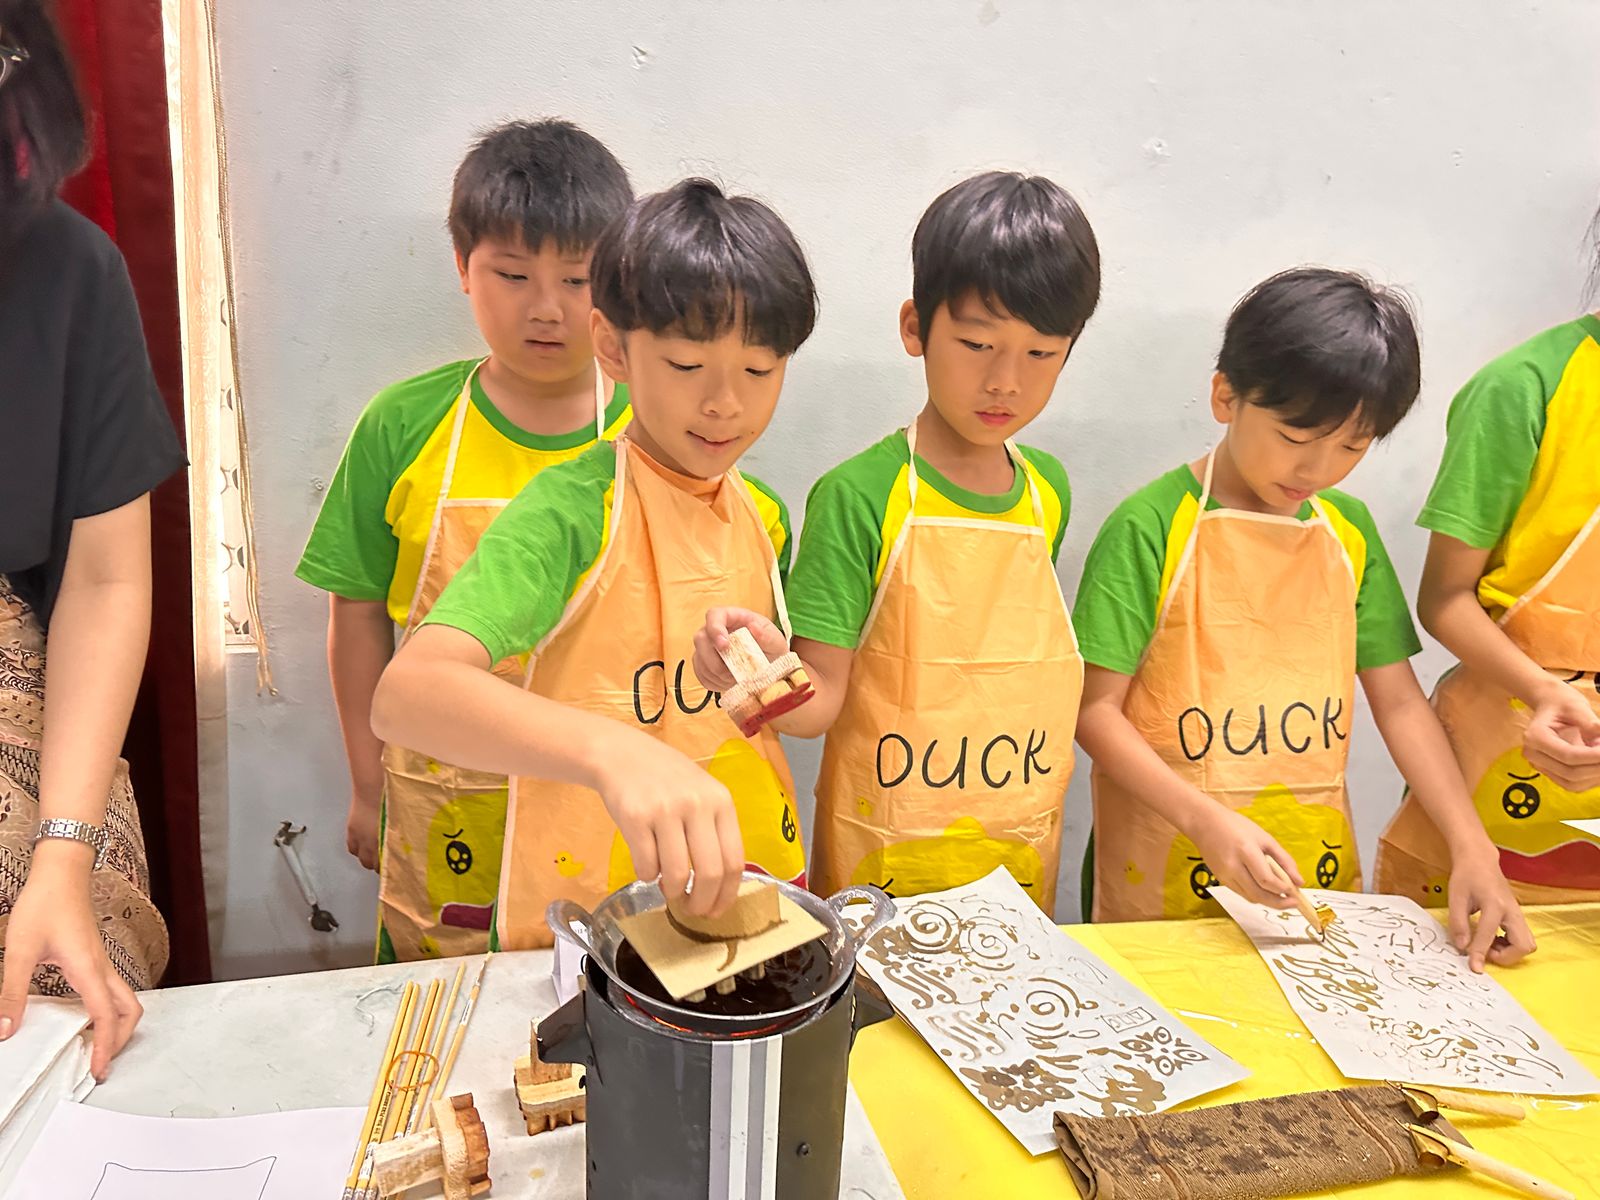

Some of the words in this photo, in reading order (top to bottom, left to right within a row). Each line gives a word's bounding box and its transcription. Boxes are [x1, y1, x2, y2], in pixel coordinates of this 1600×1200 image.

[633, 660, 721, 724] DU
[876, 729, 1051, 789] DUCK
[1178, 697, 1347, 760] DUCK
